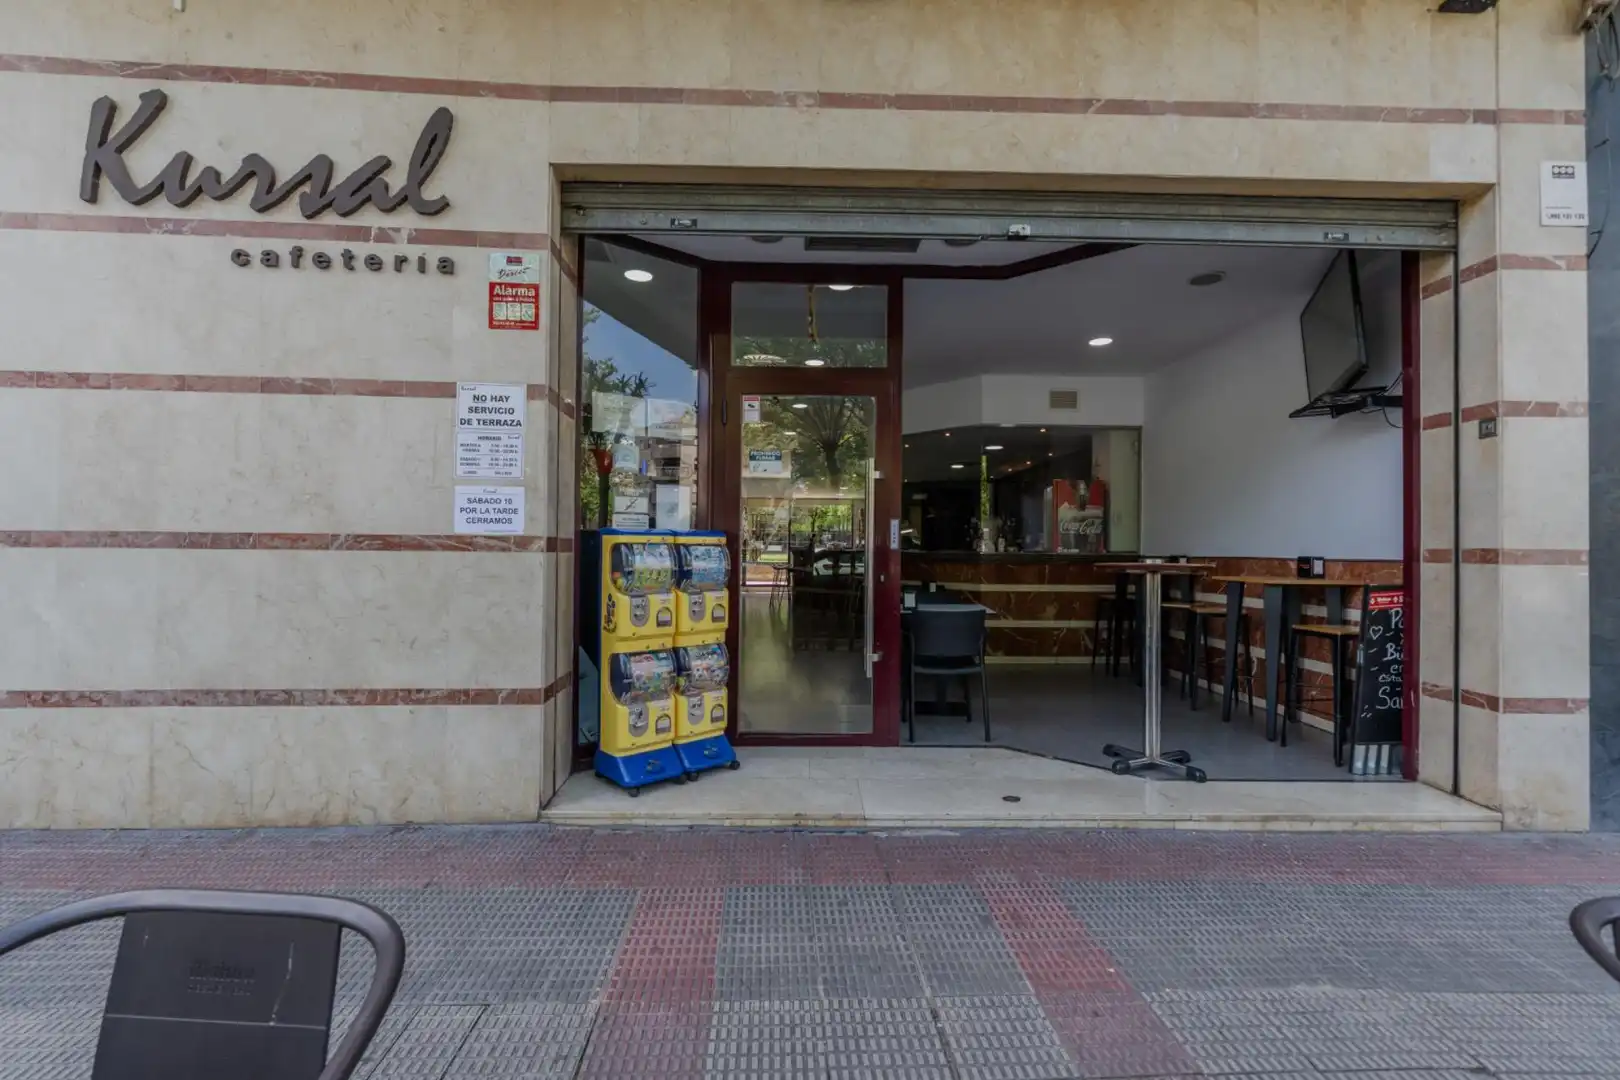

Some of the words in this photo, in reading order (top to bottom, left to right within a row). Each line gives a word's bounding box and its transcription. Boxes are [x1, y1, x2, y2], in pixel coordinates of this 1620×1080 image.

[79, 88, 454, 219] Kursal
[494, 285, 536, 296] Alarma
[472, 394, 488, 403] NO
[490, 395, 511, 403] HAY
[467, 406, 515, 415] SERVICIO
[460, 417, 473, 426] DE
[476, 418, 522, 427] TERRAZA
[480, 507, 491, 515] LA
[492, 507, 519, 515] TARDE
[465, 517, 513, 525] CERRAMOS
